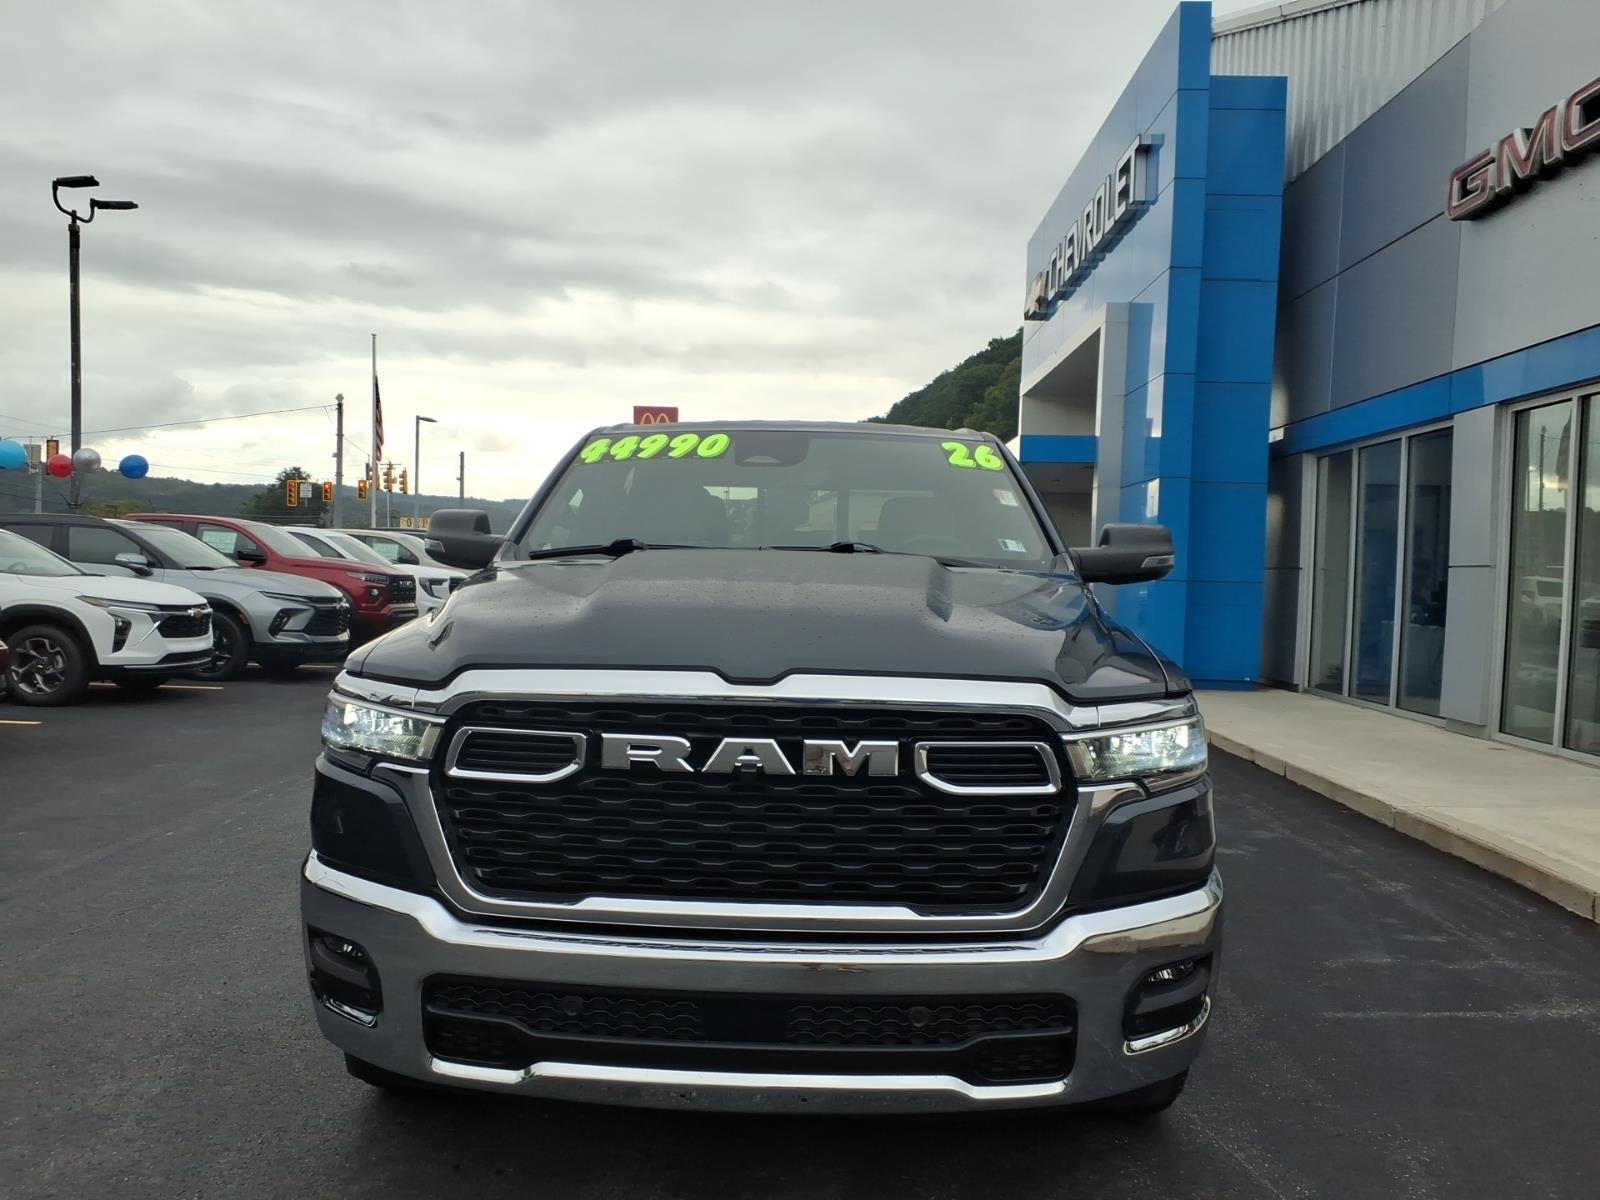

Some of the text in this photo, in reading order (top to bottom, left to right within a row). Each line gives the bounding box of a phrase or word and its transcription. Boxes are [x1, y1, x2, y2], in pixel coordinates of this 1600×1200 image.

[1448, 78, 1600, 219] GMC
[1048, 133, 1150, 301] CHEVROLET
[580, 433, 730, 464] 44990
[941, 441, 1004, 471] 26
[601, 733, 899, 776] RAM
